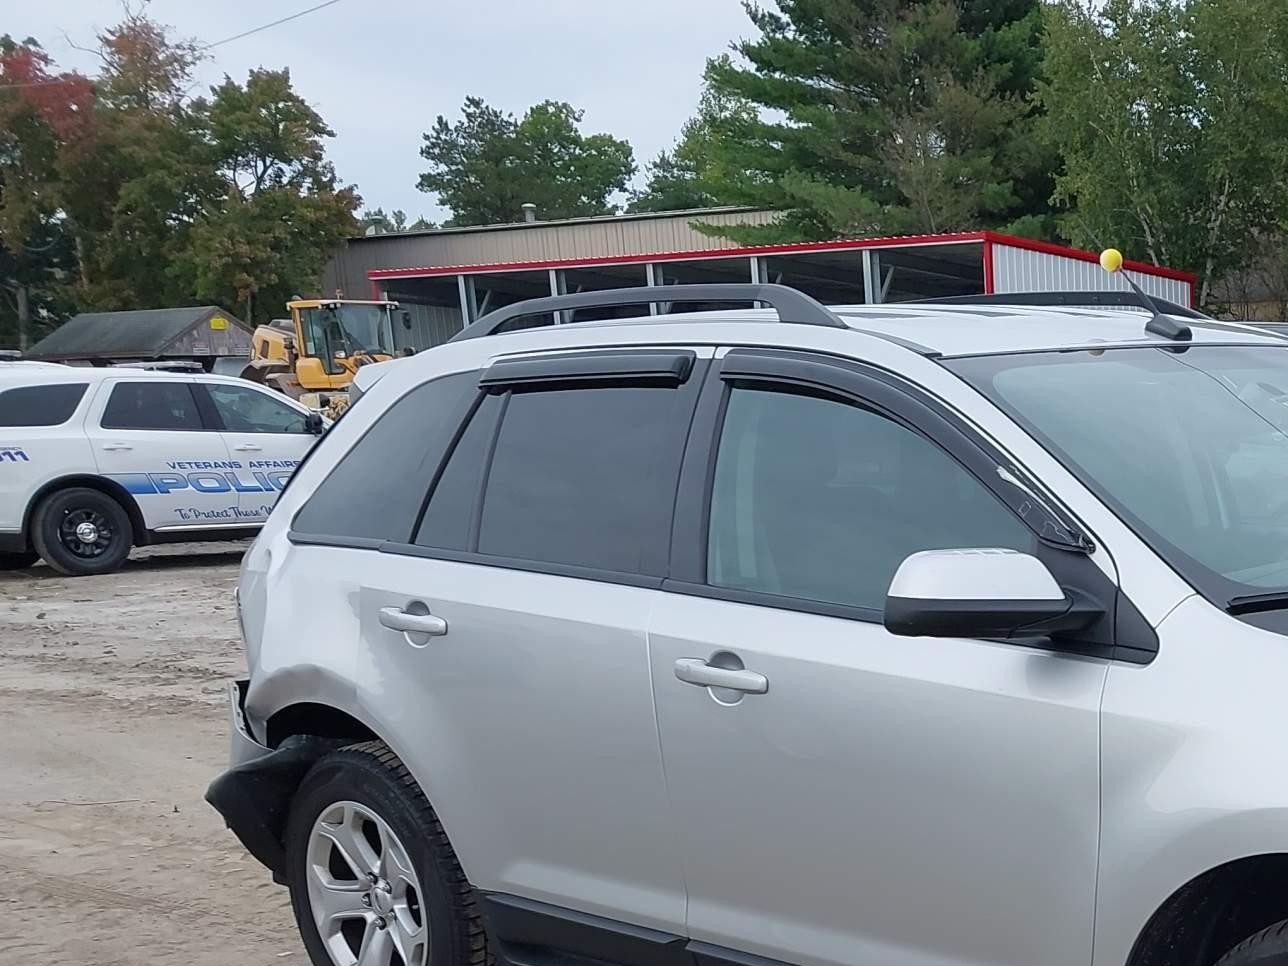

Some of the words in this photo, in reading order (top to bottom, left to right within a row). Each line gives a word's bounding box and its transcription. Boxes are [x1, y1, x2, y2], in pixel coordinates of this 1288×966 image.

[166, 461, 242, 470] VETERANS
[174, 508, 190, 520] To
[189, 507, 231, 519] Protect
[228, 506, 261, 518] Those
